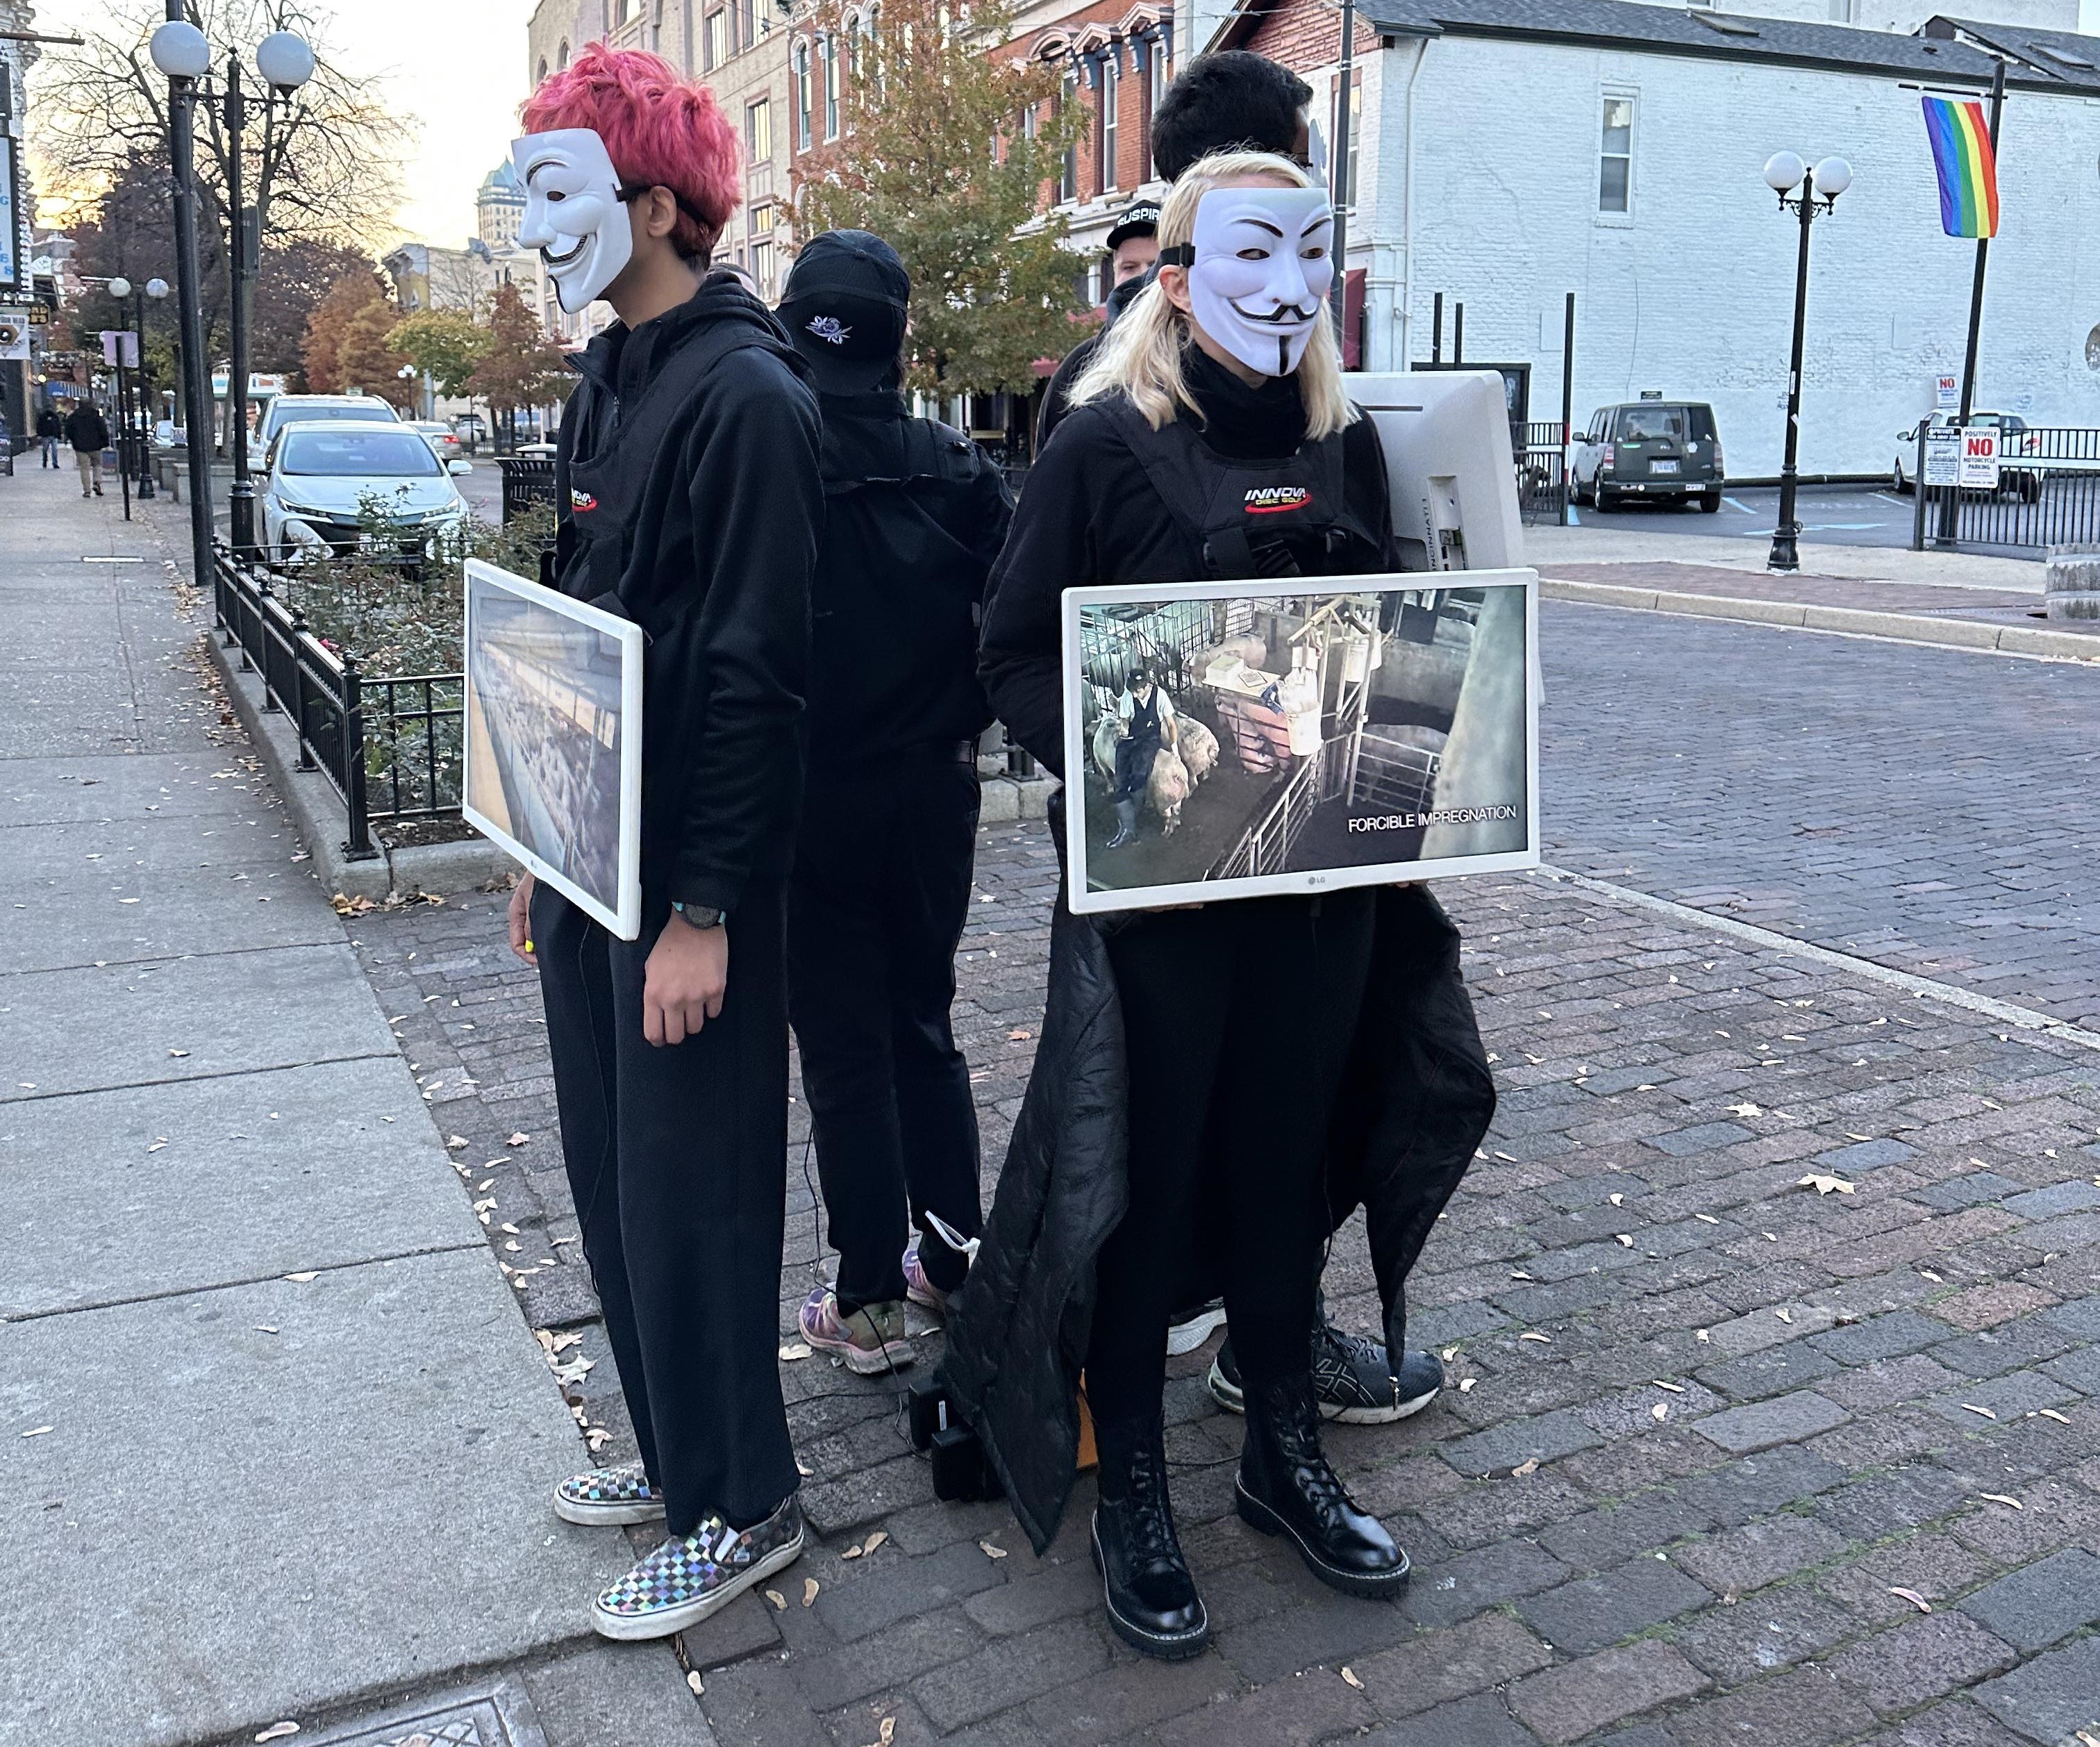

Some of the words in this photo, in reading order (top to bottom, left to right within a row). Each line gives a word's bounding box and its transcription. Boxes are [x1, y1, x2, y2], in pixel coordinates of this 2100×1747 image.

[1940, 378, 1955, 388] NO
[1967, 438, 1993, 456] NO
[1244, 488, 1306, 500] INNOVA
[1349, 813, 1416, 833] FORCIBLE
[1418, 805, 1517, 827] IMPREGNATION
